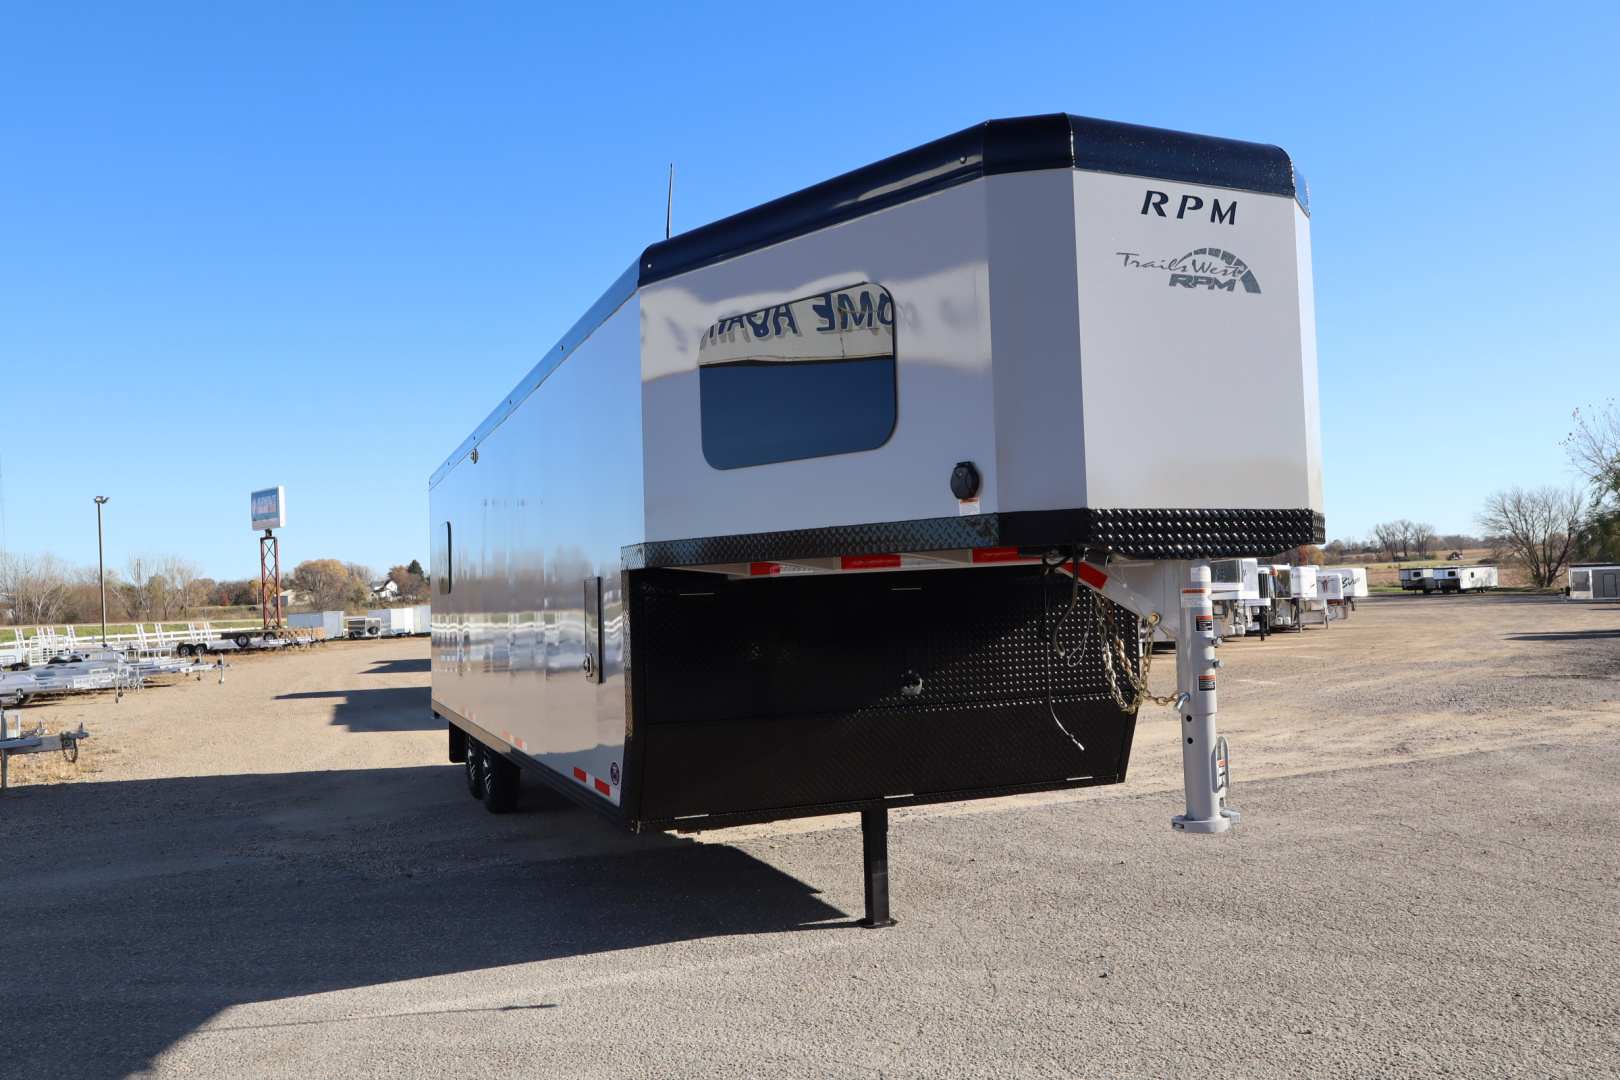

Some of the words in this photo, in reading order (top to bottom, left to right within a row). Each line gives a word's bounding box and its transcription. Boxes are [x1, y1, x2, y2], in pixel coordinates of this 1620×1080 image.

[1141, 190, 1237, 225] RPM
[1116, 252, 1188, 272] Trails
[1191, 259, 1242, 278] West
[1168, 273, 1236, 292] RPM
